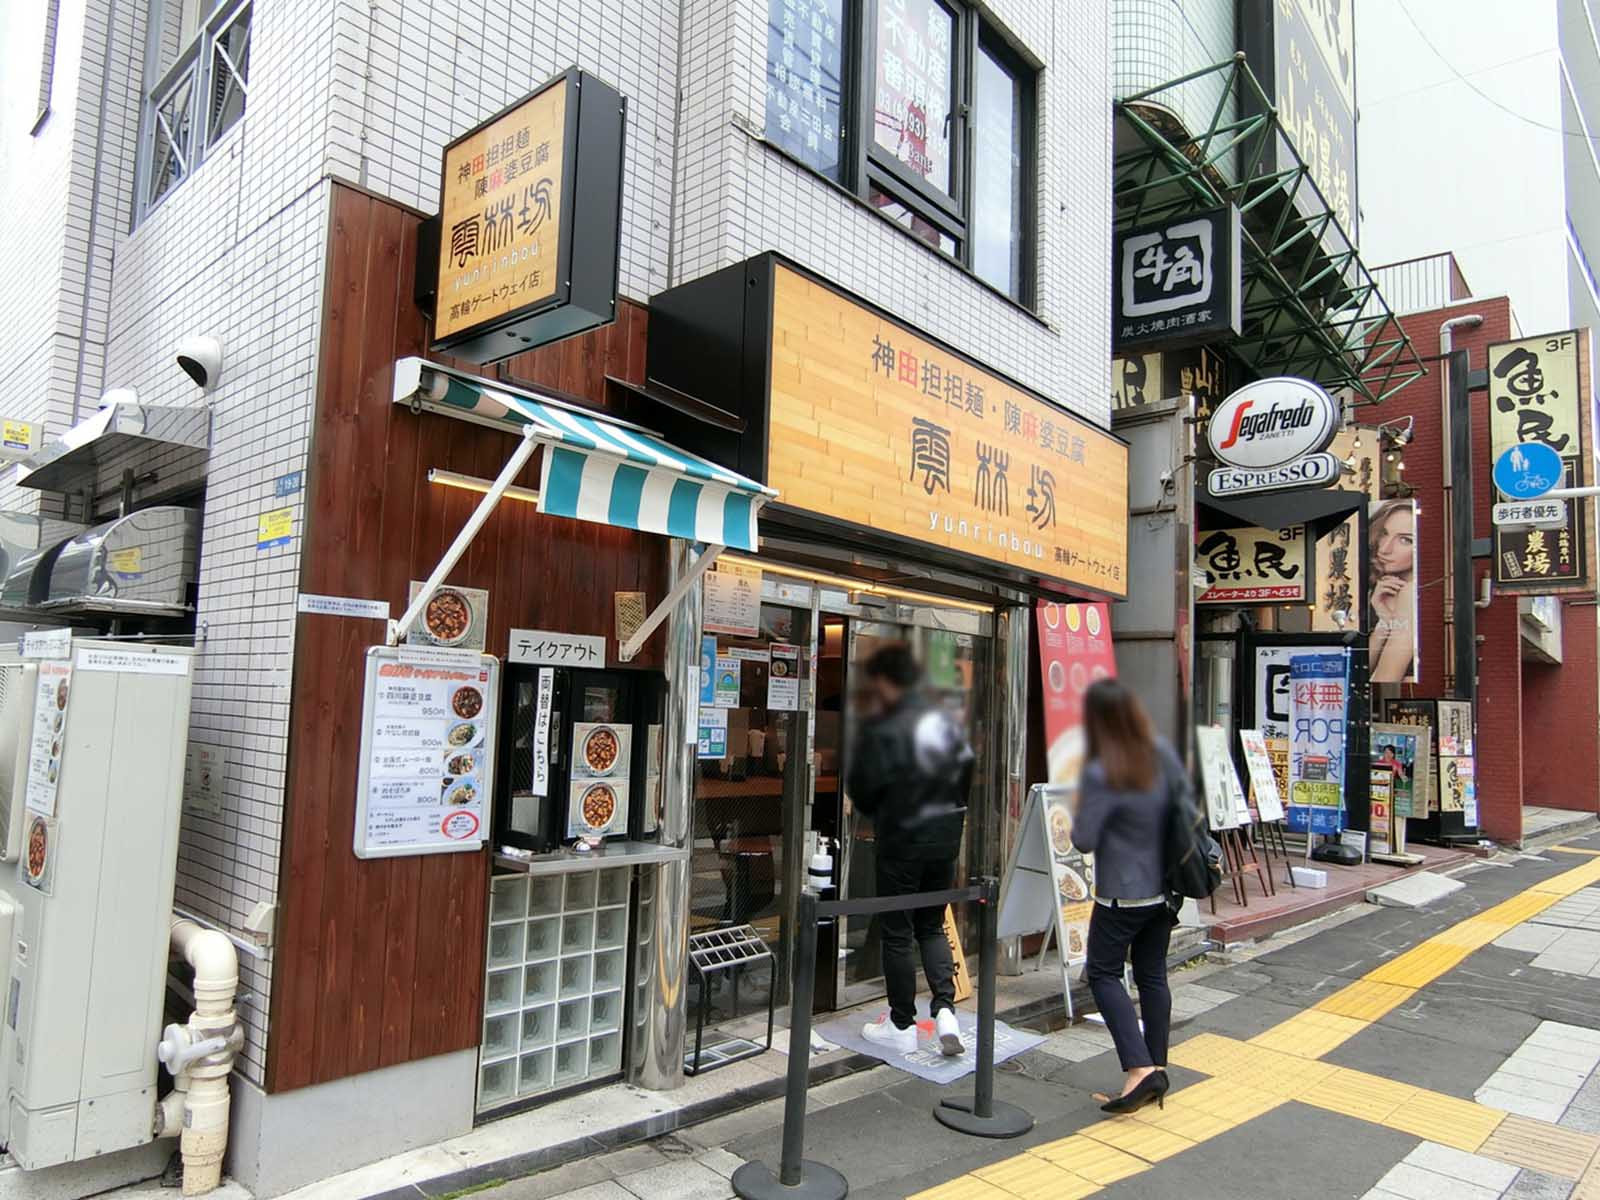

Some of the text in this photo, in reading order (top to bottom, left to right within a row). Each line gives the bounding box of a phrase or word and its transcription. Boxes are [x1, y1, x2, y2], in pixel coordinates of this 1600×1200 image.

[474, 142, 551, 201] 陳麻婆豆腐
[448, 177, 554, 269] 雲林坊
[454, 244, 540, 291] yunrinbou
[1134, 244, 1203, 293] 牛角
[449, 270, 542, 320] 高輪ゲートウェイ店
[1545, 336, 1573, 353] 3F
[1493, 347, 1571, 452] 魚民
[1220, 397, 1315, 450] Segafredo
[1258, 429, 1296, 441] ZANETTI
[910, 416, 1057, 531] 雲林坊
[1217, 460, 1321, 491] ESPRESSO
[928, 511, 1044, 559] yunrinbou
[1279, 527, 1304, 541] 3F
[1497, 505, 1559, 520] 歩行者優先
[1053, 546, 1121, 582] 高輪ゲートウェイ店
[1200, 531, 1300, 584] 魚民
[1522, 530, 1552, 574] 農場
[517, 639, 598, 662] テイクアウト
